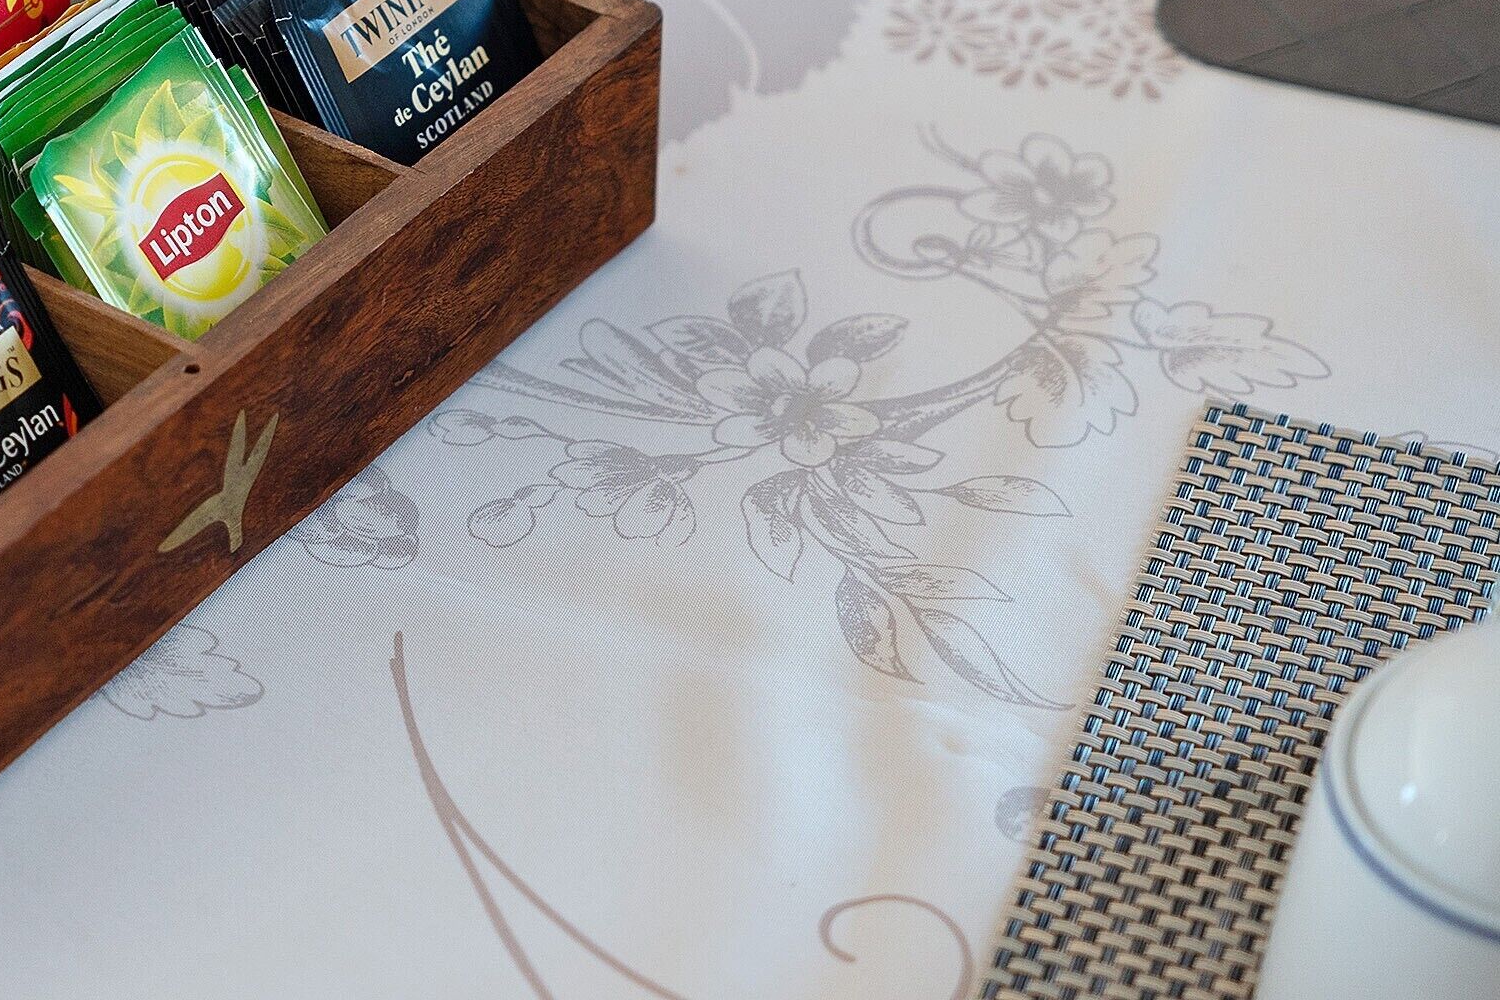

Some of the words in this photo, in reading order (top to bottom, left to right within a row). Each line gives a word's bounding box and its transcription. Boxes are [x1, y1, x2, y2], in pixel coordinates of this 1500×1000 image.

[388, 33, 401, 46] OF
[401, 6, 435, 37] LONDON
[401, 28, 450, 79] Thé
[393, 106, 413, 127] de
[410, 43, 490, 114] Ceylan
[415, 80, 494, 149] SCOTLAND
[149, 188, 233, 266] Lipton
